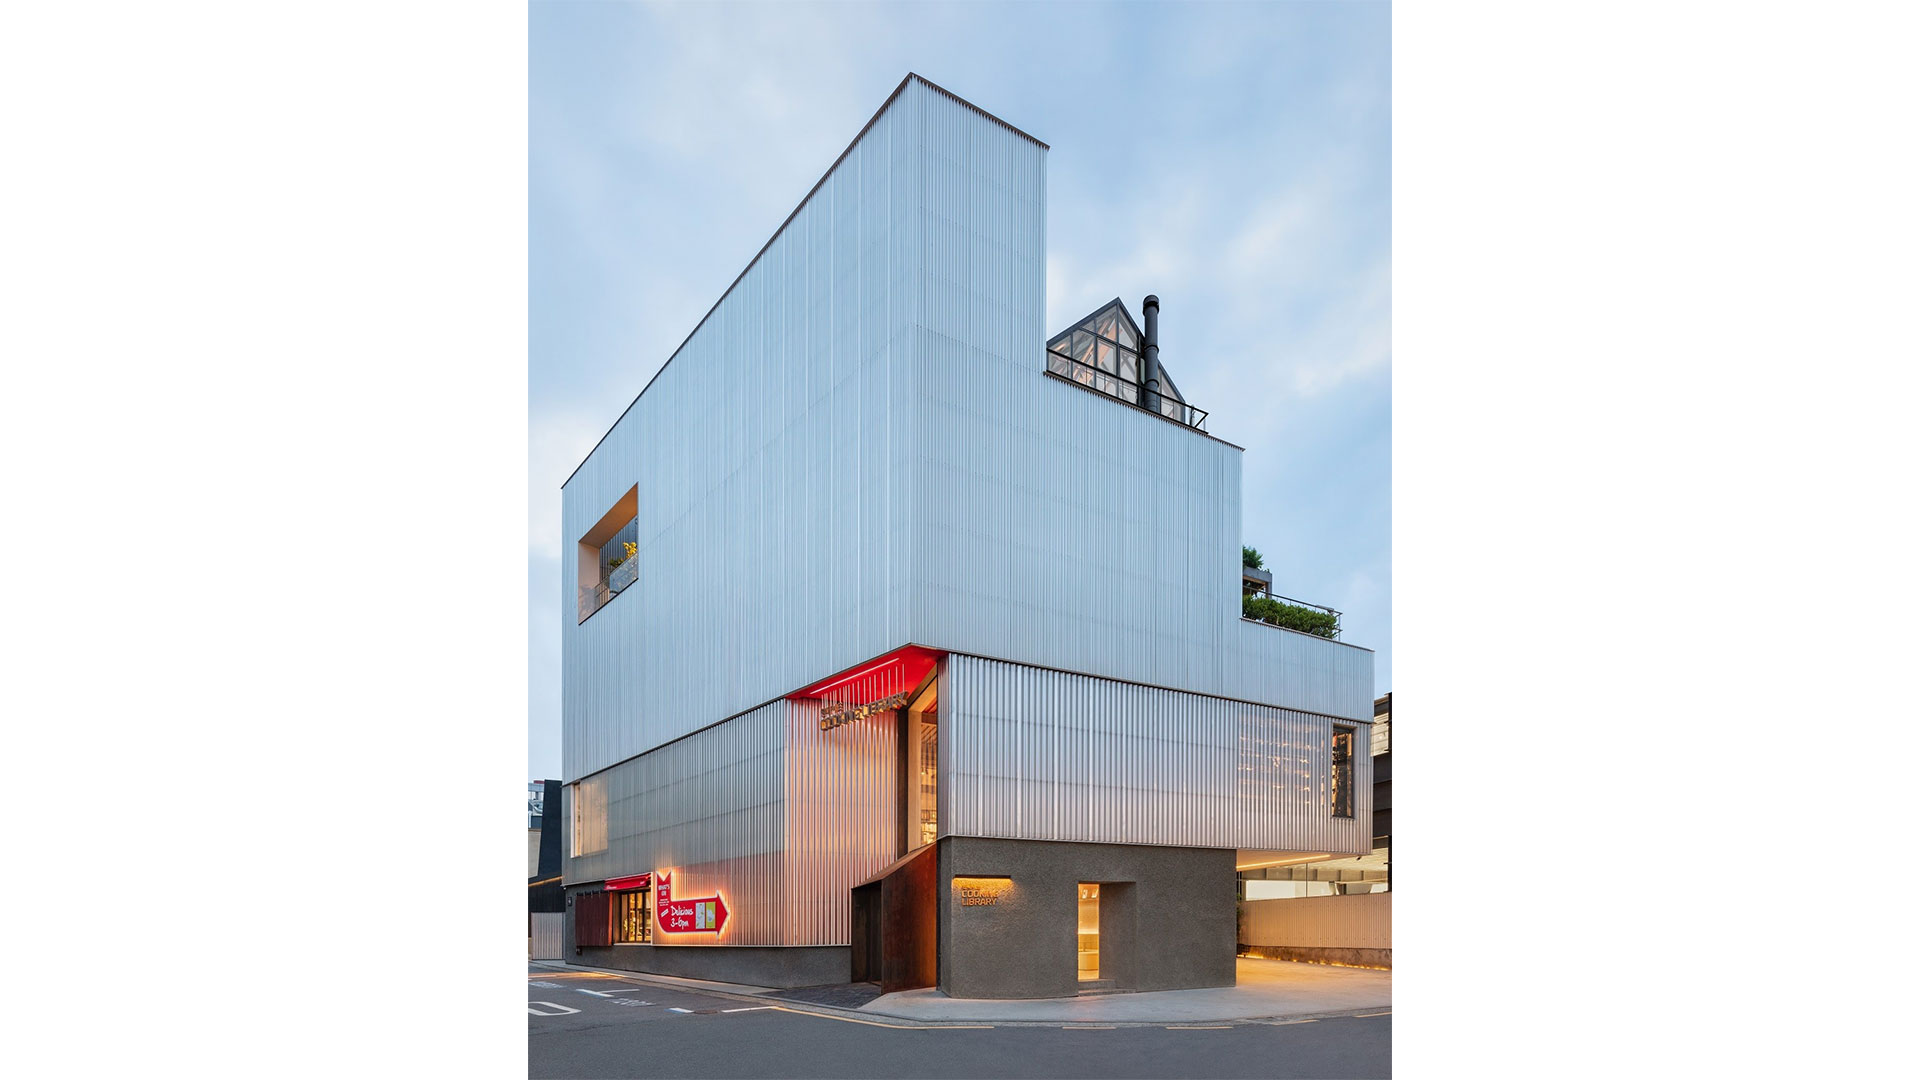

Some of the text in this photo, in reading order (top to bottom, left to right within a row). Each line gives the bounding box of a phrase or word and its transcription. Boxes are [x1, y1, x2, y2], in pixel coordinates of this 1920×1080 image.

[961, 889, 999, 898] COOKING
[961, 898, 998, 906] LIBRARY
[670, 905, 693, 916] Delicious
